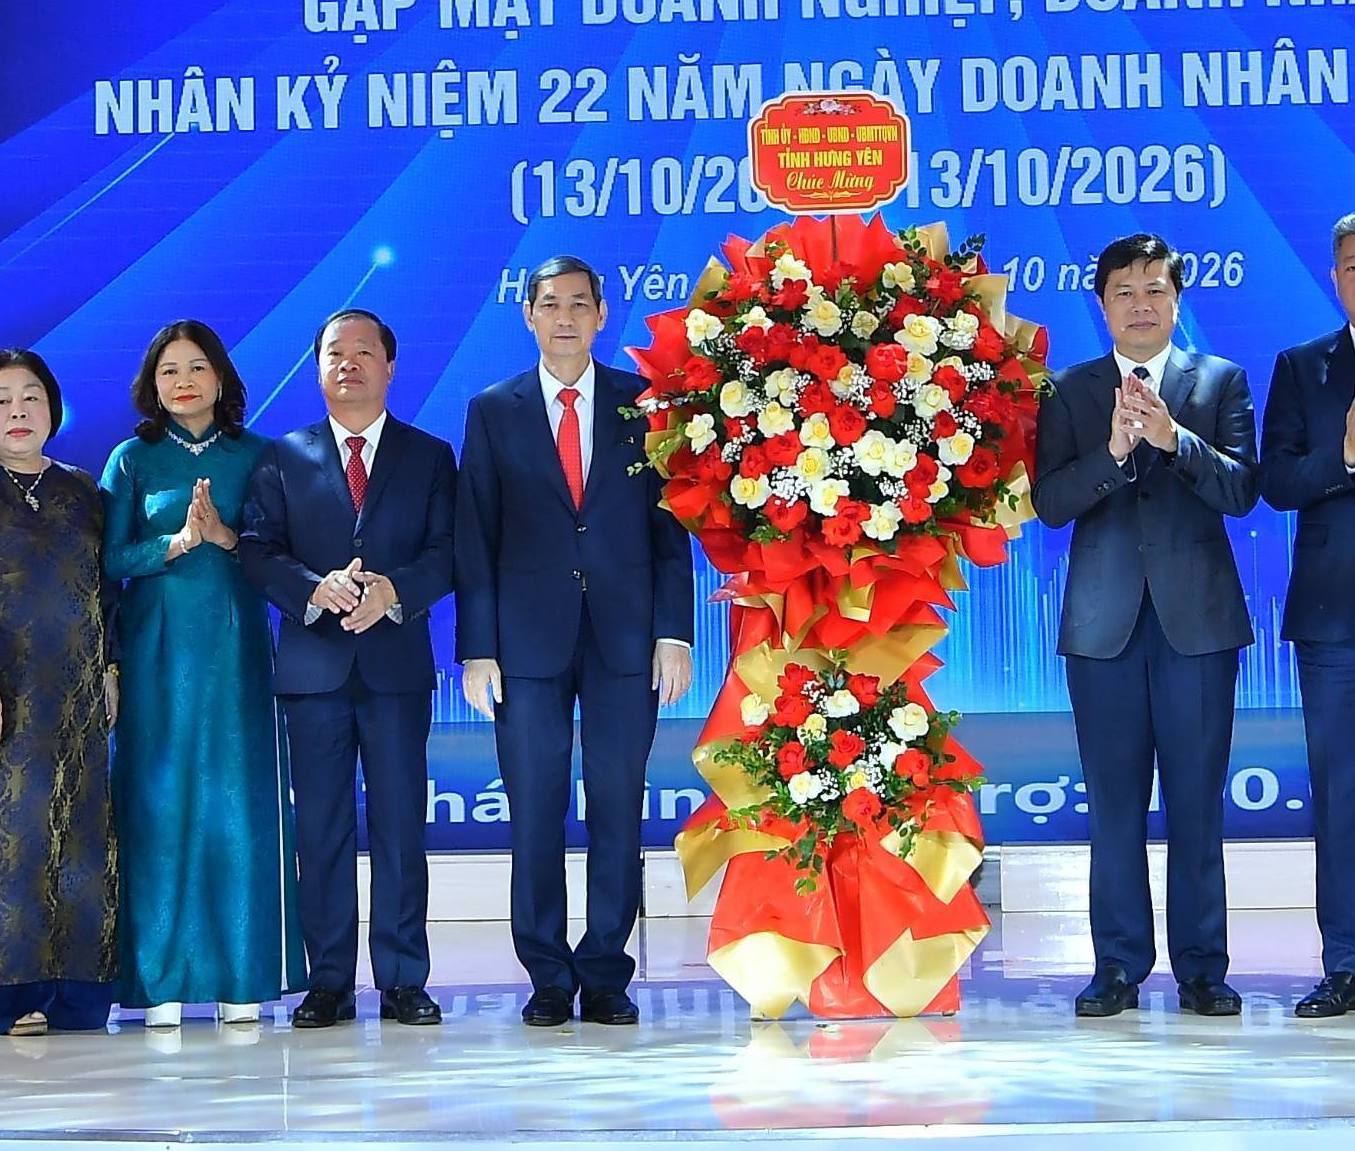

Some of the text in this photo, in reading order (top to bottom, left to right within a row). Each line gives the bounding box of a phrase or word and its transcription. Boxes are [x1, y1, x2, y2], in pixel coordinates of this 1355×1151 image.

[94, 66, 255, 135] NHÂN
[276, 55, 348, 131] KỶ
[367, 59, 518, 139] NIỆM
[539, 67, 608, 124] 22
[628, 53, 763, 121] NĂM
[961, 53, 1161, 113] DOANH
[1182, 37, 1349, 108] NHÂN
[778, 146, 883, 169] TỈNH HƯNG YÊN
[786, 169, 874, 192] Chúc Mừng
[511, 144, 1227, 224] (13/10/20 13/10/2026)
[619, 252, 1245, 301] Yên 10 nă 026
[980, 775, 1088, 824] rợ:
